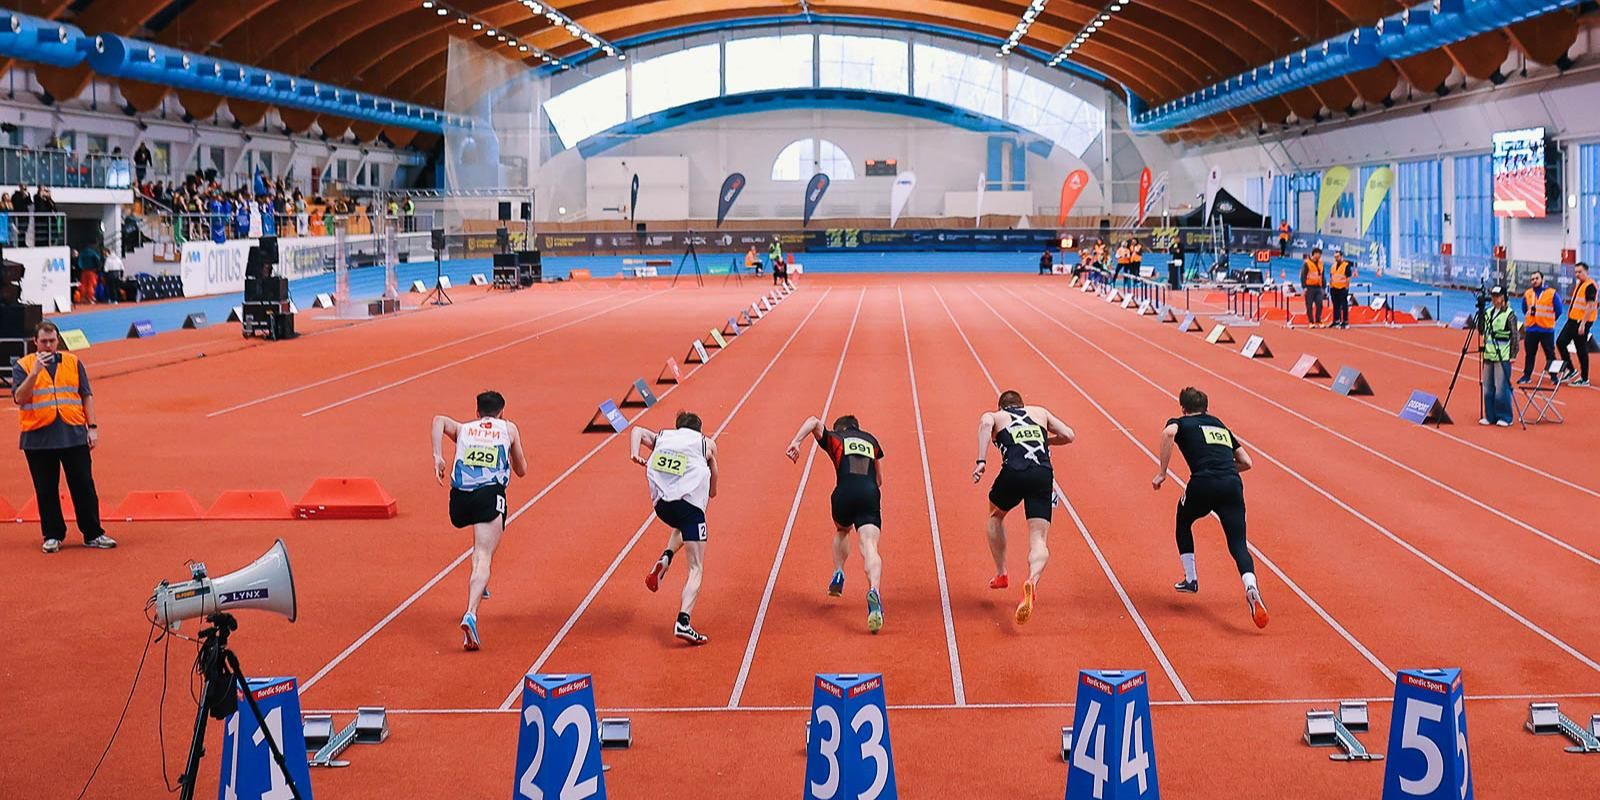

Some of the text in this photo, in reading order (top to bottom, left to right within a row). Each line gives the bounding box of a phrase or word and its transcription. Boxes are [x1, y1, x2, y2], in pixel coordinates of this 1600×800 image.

[207, 248, 241, 284] CITIUS
[467, 451, 495, 463] 429
[468, 427, 500, 439] МГРИ
[657, 456, 681, 470] 312
[849, 442, 871, 454] 691
[1015, 429, 1041, 438] 485
[1209, 431, 1228, 442] 191
[700, 525, 706, 536] 2
[232, 590, 260, 600] LYNX
[225, 710, 240, 800] 1
[252, 705, 295, 800] 1
[519, 704, 544, 800] 2
[552, 703, 598, 800] 2
[811, 704, 841, 800] 3
[850, 703, 889, 800] 3
[1073, 699, 1109, 800] 4
[1120, 699, 1150, 796] 4
[1398, 697, 1444, 796] 5
[1454, 693, 1469, 800] 5
